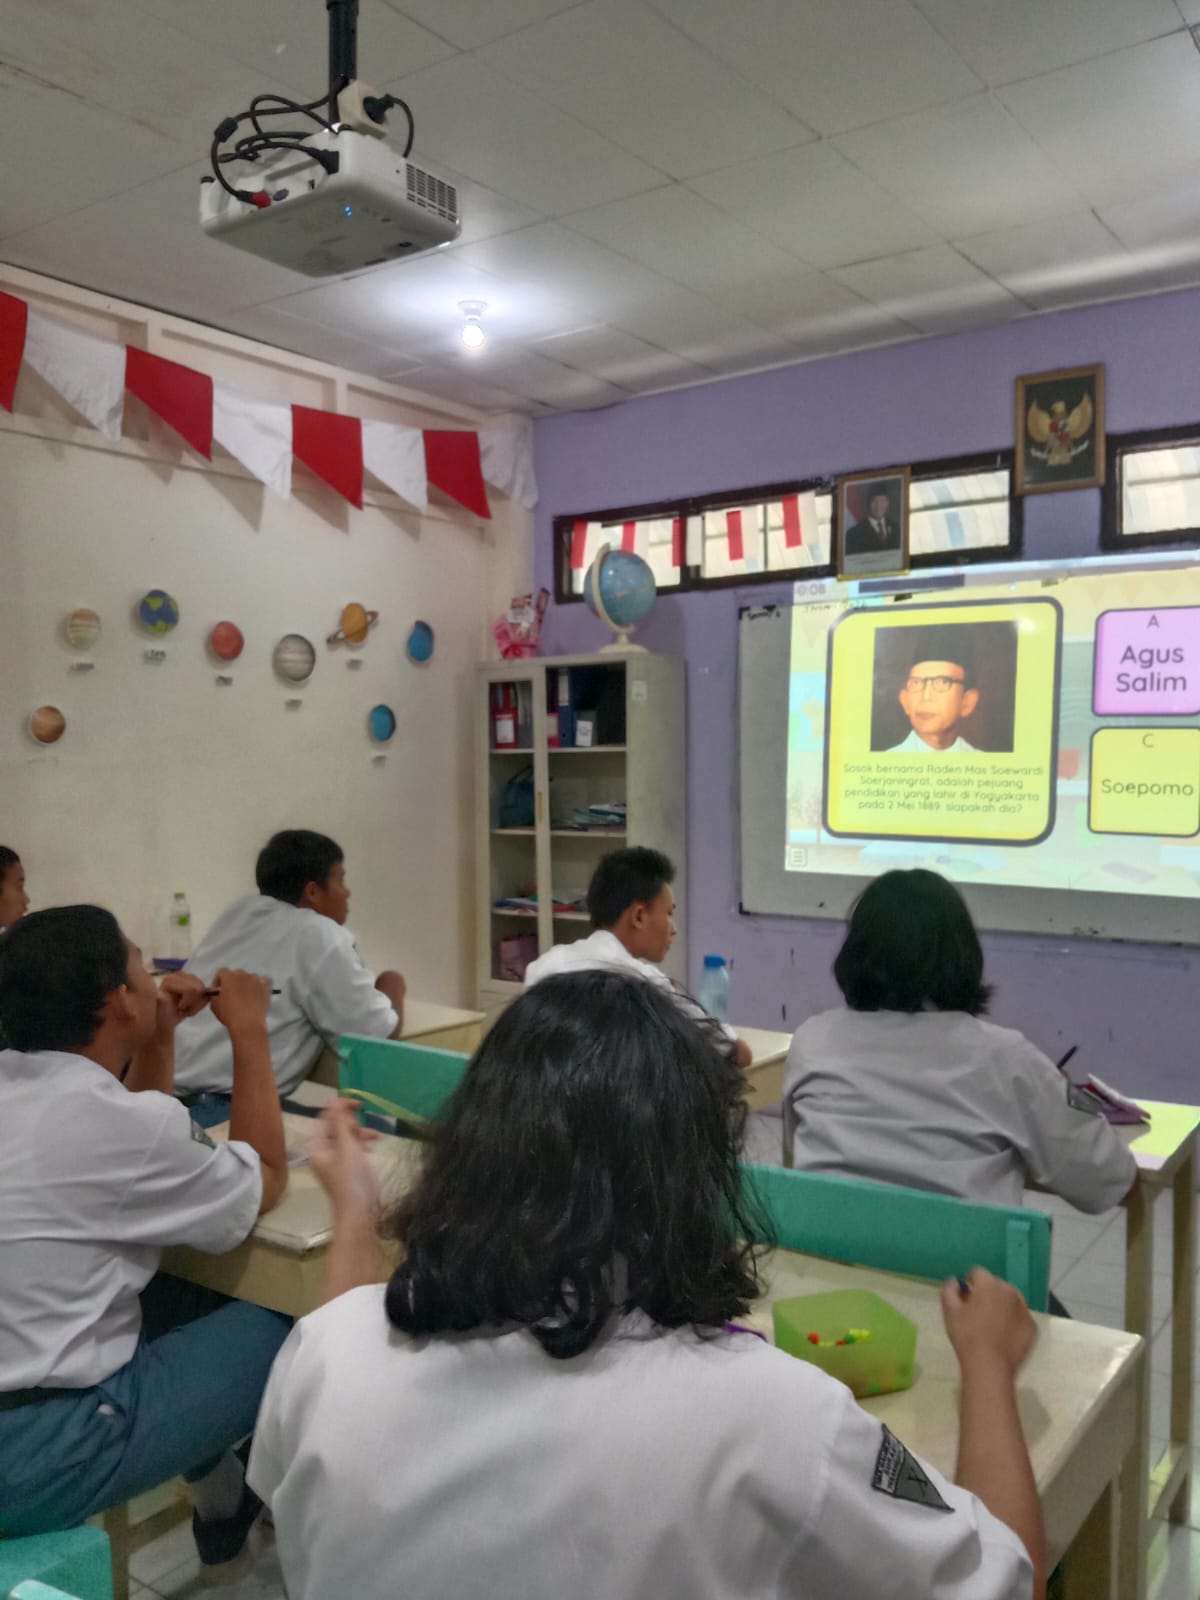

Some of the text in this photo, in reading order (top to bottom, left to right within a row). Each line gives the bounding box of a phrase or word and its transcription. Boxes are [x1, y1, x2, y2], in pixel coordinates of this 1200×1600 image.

[1146, 614, 1161, 629] A
[1119, 644, 1185, 669] Agus
[1115, 672, 1187, 693] Salim
[1142, 733, 1155, 748] C
[843, 763, 1043, 776] Sosok bernama Raden Mas Soewardi
[936, 776, 974, 786] adalah
[977, 778, 1024, 790] pejuang
[1101, 778, 1194, 797] Soepomo
[844, 788, 1040, 802] pendidikan yang lahir di Yogyakarta
[858, 799, 885, 810] pada
[887, 800, 893, 809] 2
[896, 800, 915, 810] Mei
[946, 801, 995, 813] siapakah
[999, 803, 1023, 814] dia?
